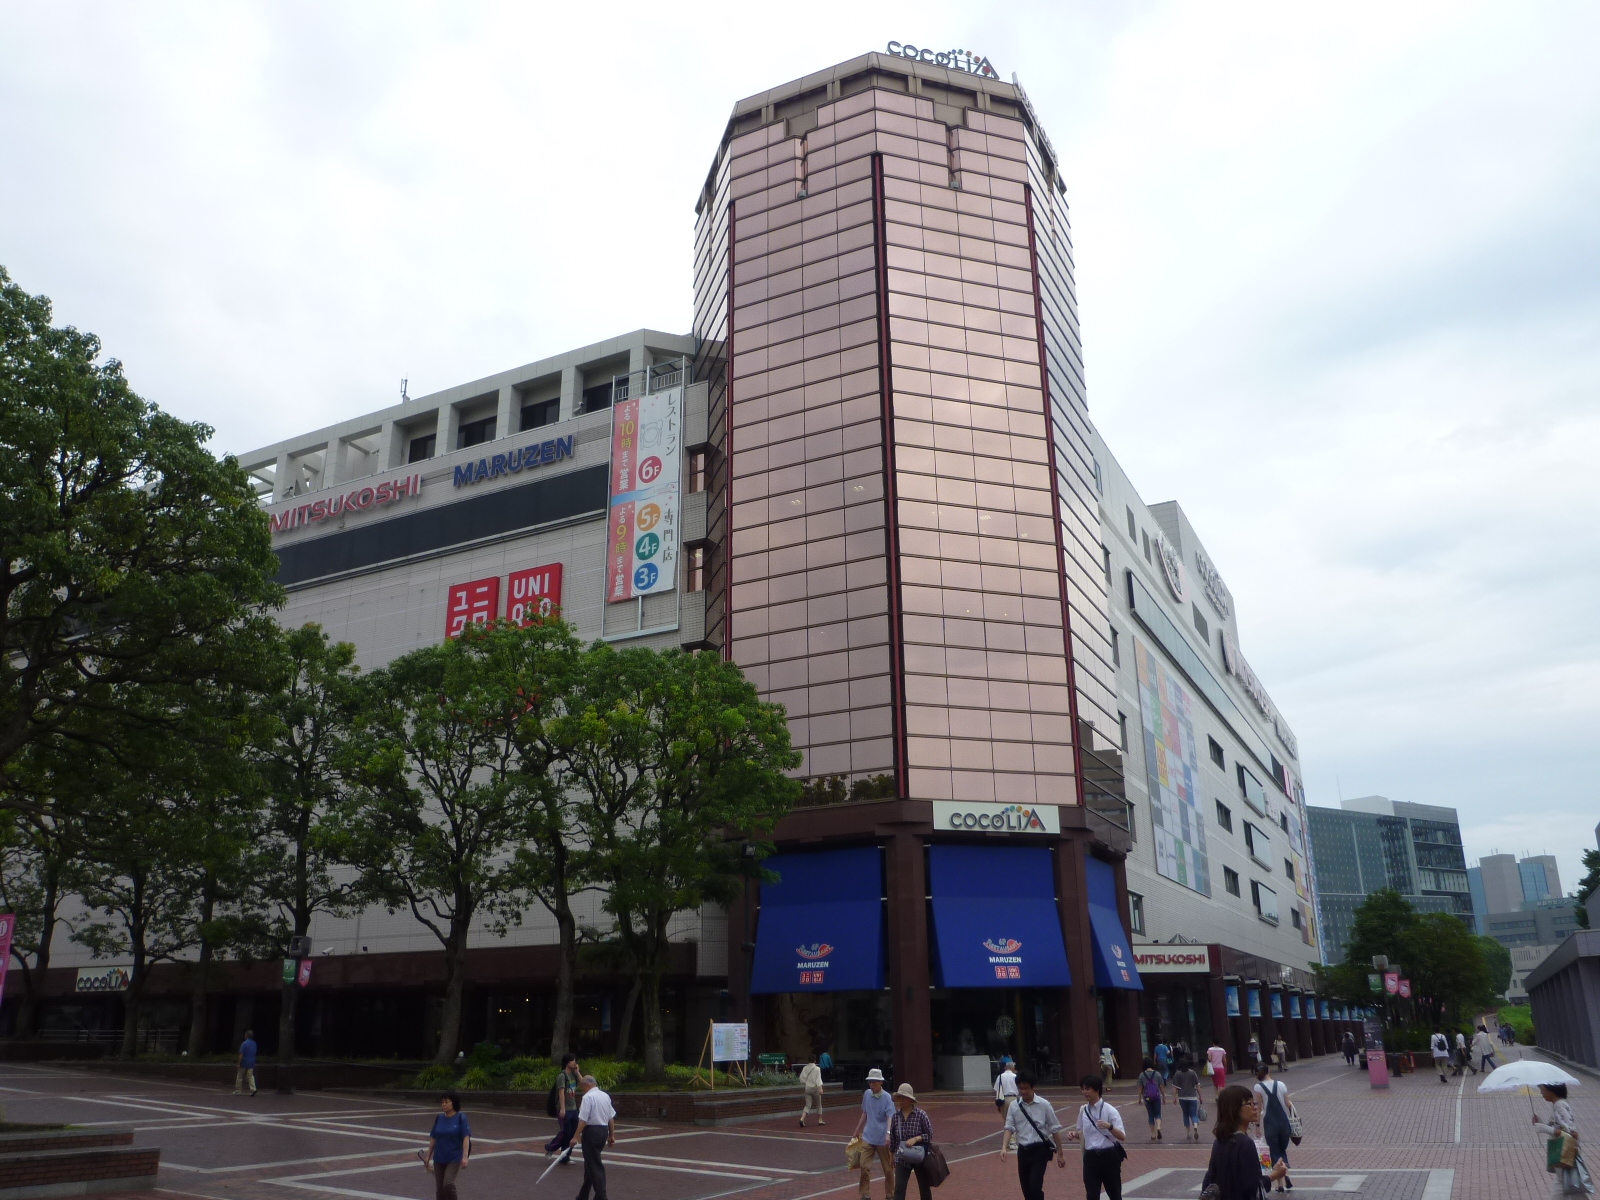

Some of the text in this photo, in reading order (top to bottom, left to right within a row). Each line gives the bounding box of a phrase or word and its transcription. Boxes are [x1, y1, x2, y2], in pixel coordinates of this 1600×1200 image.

[665, 393, 676, 456] レストラン
[453, 435, 574, 487] MARUZEN
[642, 460, 659, 480] 6F
[269, 474, 421, 532] MITSUKOSHI
[640, 508, 658, 528] 5F
[639, 536, 657, 556] 4F
[663, 508, 673, 563] 専門店
[513, 573, 550, 599] UNI
[638, 567, 656, 587] 3F
[949, 808, 1046, 831] COCOLIA
[797, 961, 829, 969] MARUZEN
[1133, 954, 1206, 965] MITSUKOSHI
